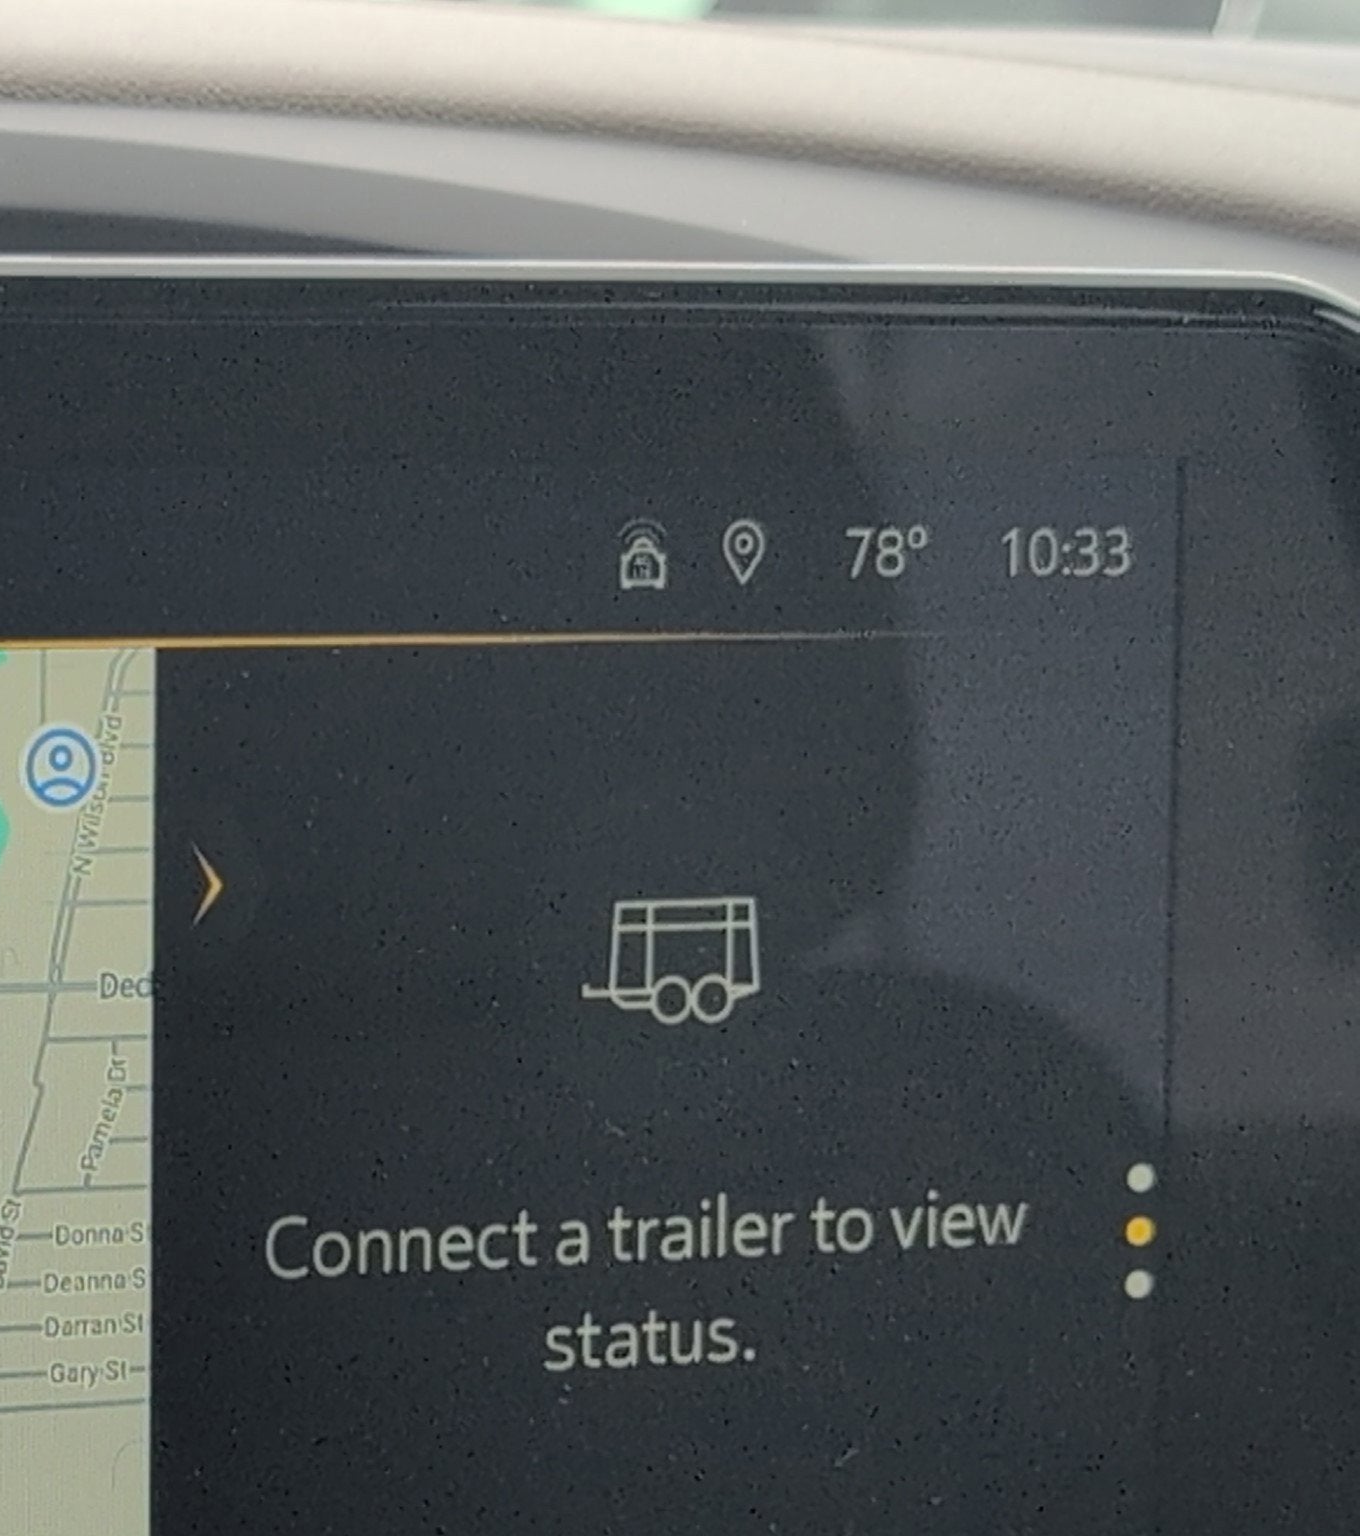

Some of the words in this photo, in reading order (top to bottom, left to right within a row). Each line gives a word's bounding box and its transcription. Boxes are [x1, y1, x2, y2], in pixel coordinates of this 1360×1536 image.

[1000, 526, 1133, 578] 10:33
[73, 855, 92, 876] N
[81, 1089, 123, 1172] Pamela
[107, 1058, 127, 1083] Dr
[55, 1224, 124, 1246] Donna
[265, 1210, 538, 1280] Connect
[556, 1219, 590, 1266] a
[608, 1192, 794, 1263] trailer
[810, 1199, 874, 1253] to
[889, 1189, 1029, 1247] view
[43, 1272, 127, 1294] Deanna
[44, 1315, 118, 1338] Darran
[543, 1312, 758, 1373] status.
[50, 1362, 97, 1388] Gary
[105, 1359, 128, 1382] St
